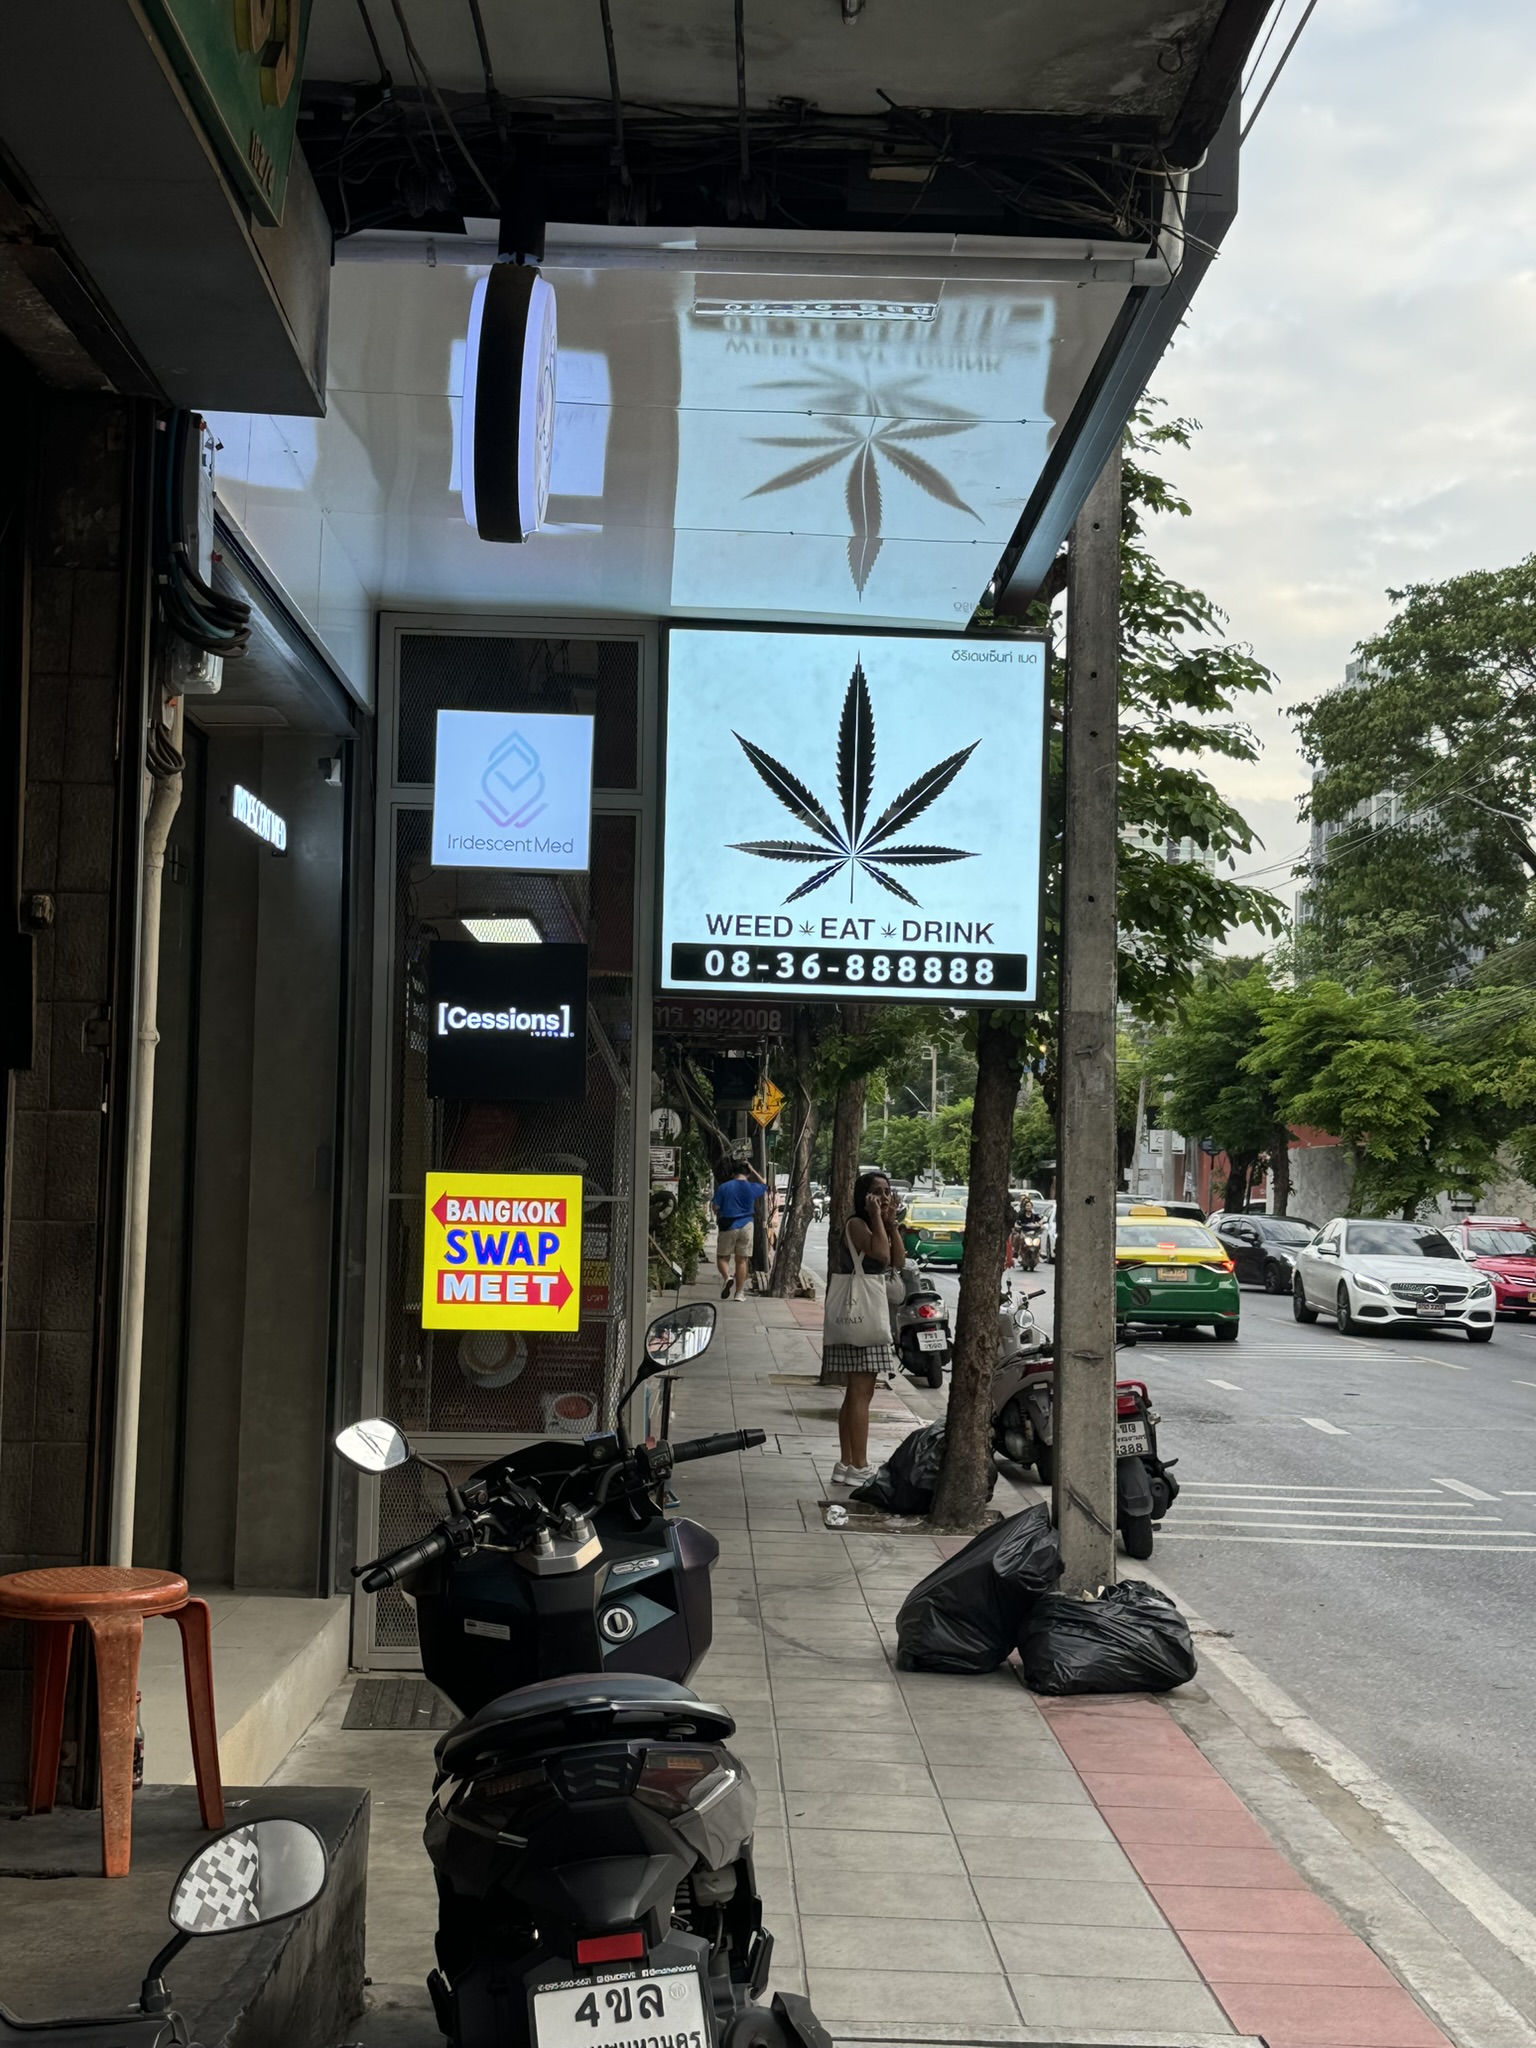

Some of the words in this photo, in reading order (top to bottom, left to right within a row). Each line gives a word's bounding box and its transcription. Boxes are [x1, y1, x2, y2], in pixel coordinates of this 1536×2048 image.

[706, 913, 793, 938] WEED
[820, 917, 876, 941] EAT
[902, 920, 995, 944] DRINK
[705, 949, 995, 985] 08-36-888888
[693, 1007, 782, 1031] 3922008
[446, 1199, 561, 1224] BANGKOK
[444, 1228, 561, 1266] SWAP
[442, 1274, 559, 1303] MEET
